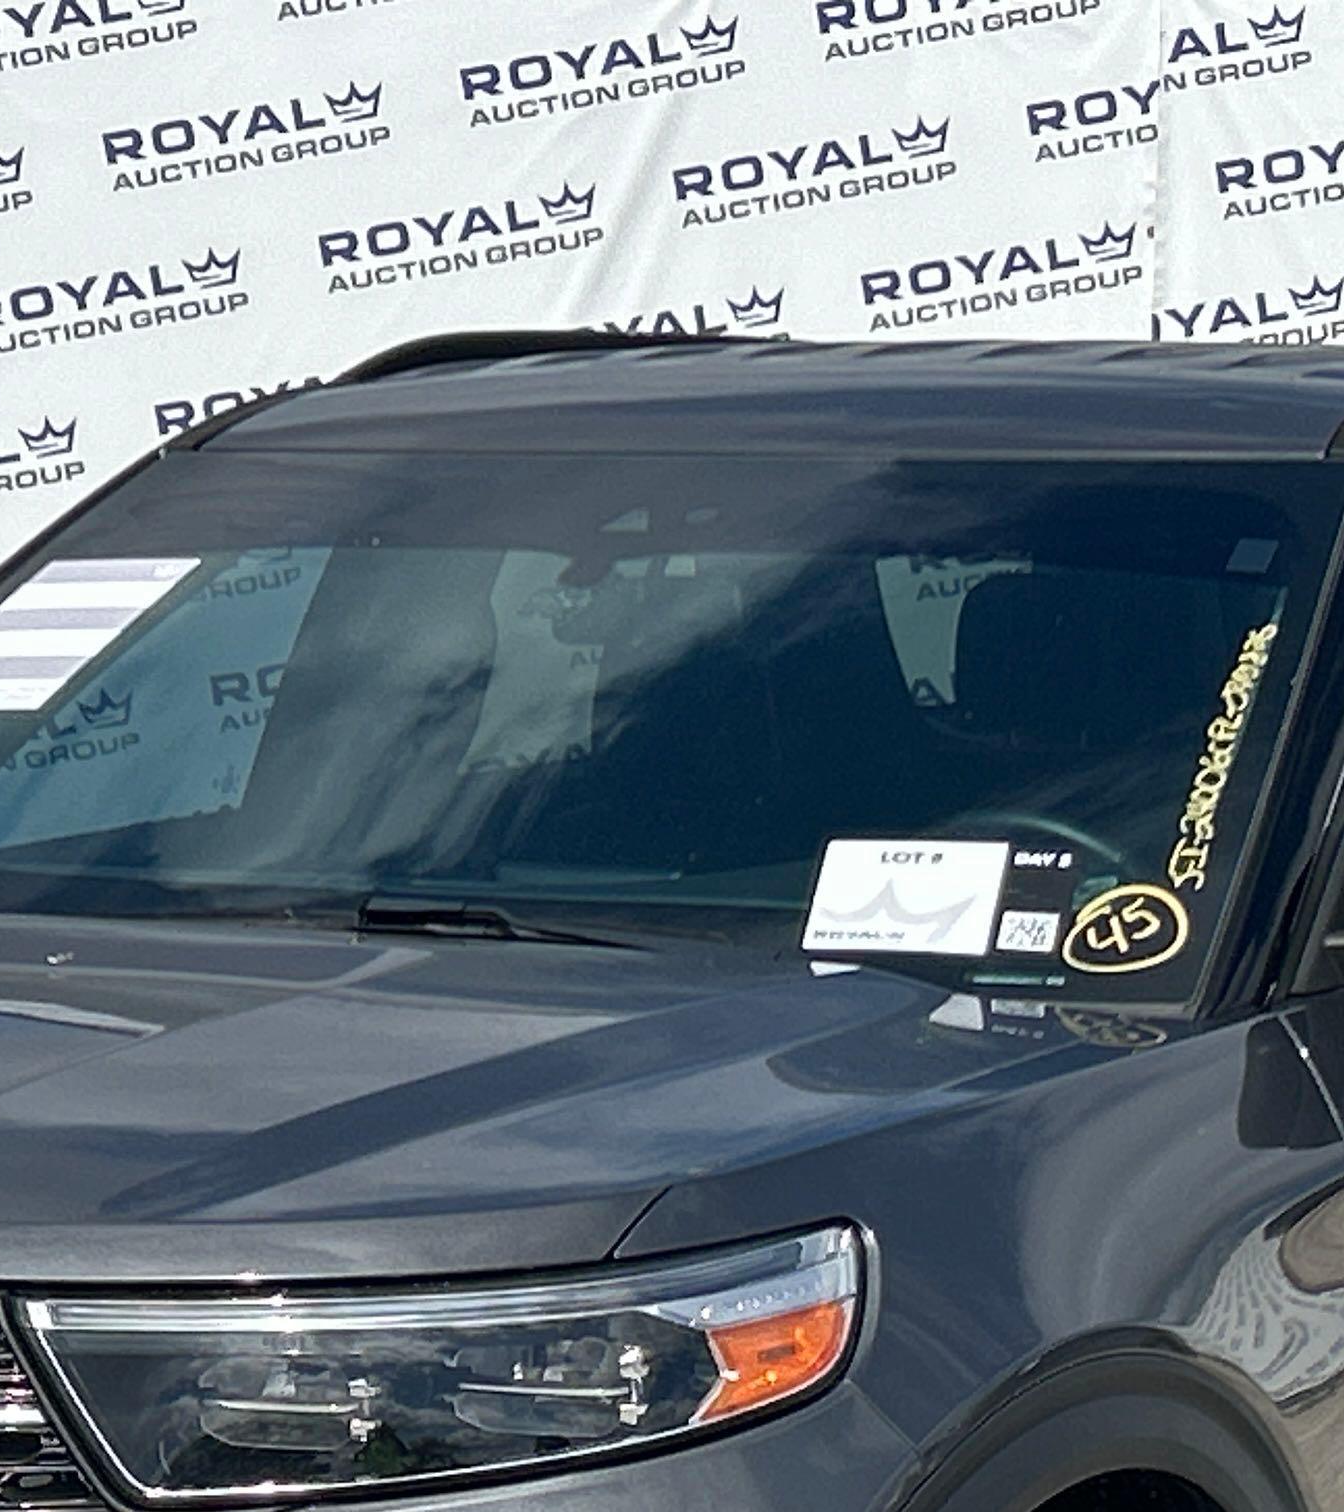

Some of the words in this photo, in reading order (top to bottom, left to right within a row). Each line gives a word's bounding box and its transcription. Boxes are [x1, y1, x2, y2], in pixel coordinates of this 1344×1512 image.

[77, 19, 198, 57] GROUP
[825, 18, 975, 63] AUCTION
[981, 0, 1101, 32] GROUP
[459, 32, 683, 101] ROYAL
[470, 82, 621, 128] AUCTION
[627, 59, 746, 98] GROUP
[1194, 50, 1313, 86] GROUP
[101, 98, 327, 166] ROYAL
[1026, 78, 1161, 137] ROY
[112, 148, 264, 192] AUCTION
[270, 126, 391, 163] GROUP
[672, 134, 894, 202] ROYAL
[1034, 123, 1159, 163] AUCTIO
[681, 184, 831, 229] AUCTION
[839, 161, 957, 199] GROUP
[318, 200, 541, 268] ROYAL
[328, 249, 478, 294] AUCTION
[484, 227, 604, 265] GROUP
[860, 238, 1080, 306] ROYAL
[869, 288, 1018, 332] AUCTION
[1025, 265, 1143, 303] GROUP
[129, 292, 249, 329] GROUP
[880, 850, 925, 865] LOT
[1085, 895, 1161, 954] 45
